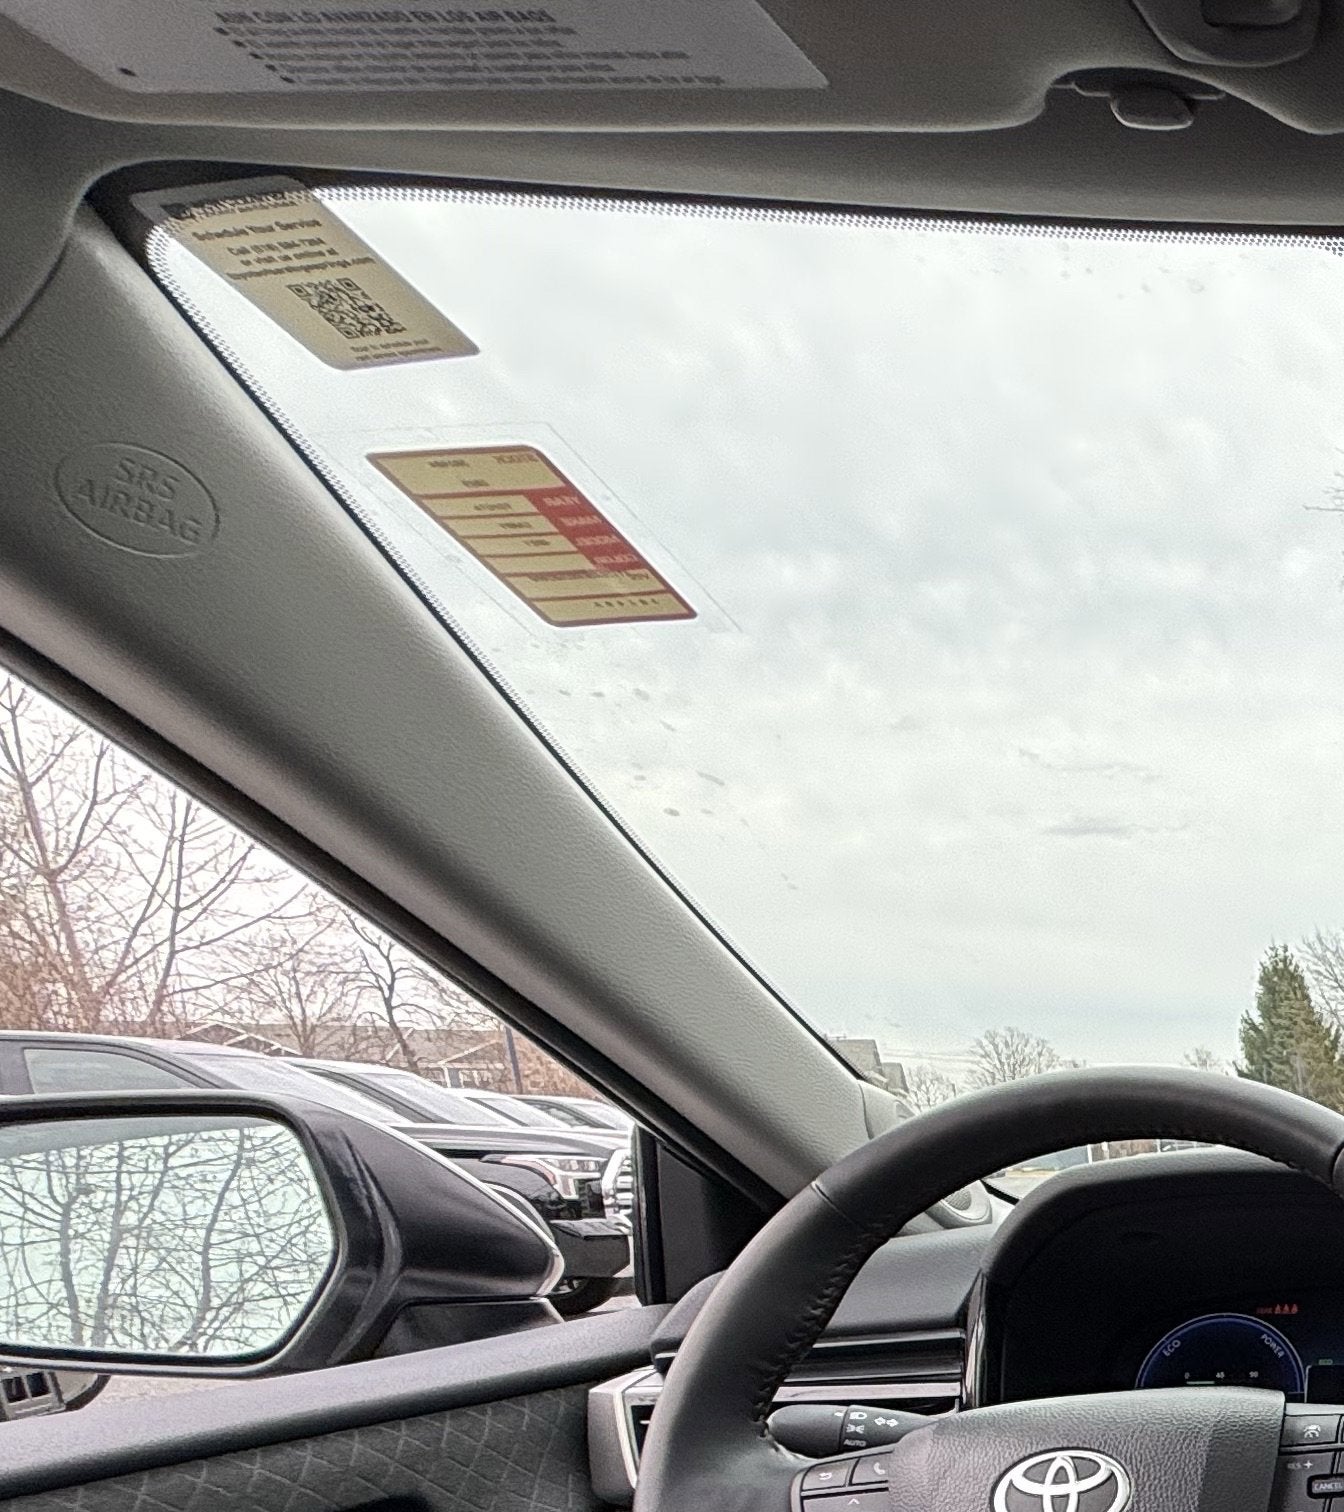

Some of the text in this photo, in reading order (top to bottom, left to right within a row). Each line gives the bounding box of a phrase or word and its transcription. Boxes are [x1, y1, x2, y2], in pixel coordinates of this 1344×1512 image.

[246, 224, 275, 234] Your
[274, 219, 322, 231] Service
[227, 245, 250, 256] Call
[112, 457, 181, 501] SRS
[70, 478, 203, 546] AIRBAG
[1162, 1339, 1182, 1357] ECO
[1260, 1333, 1286, 1359] POWER
[843, 1439, 867, 1447] AUTO
[1313, 1482, 1344, 1491] CANCEL
